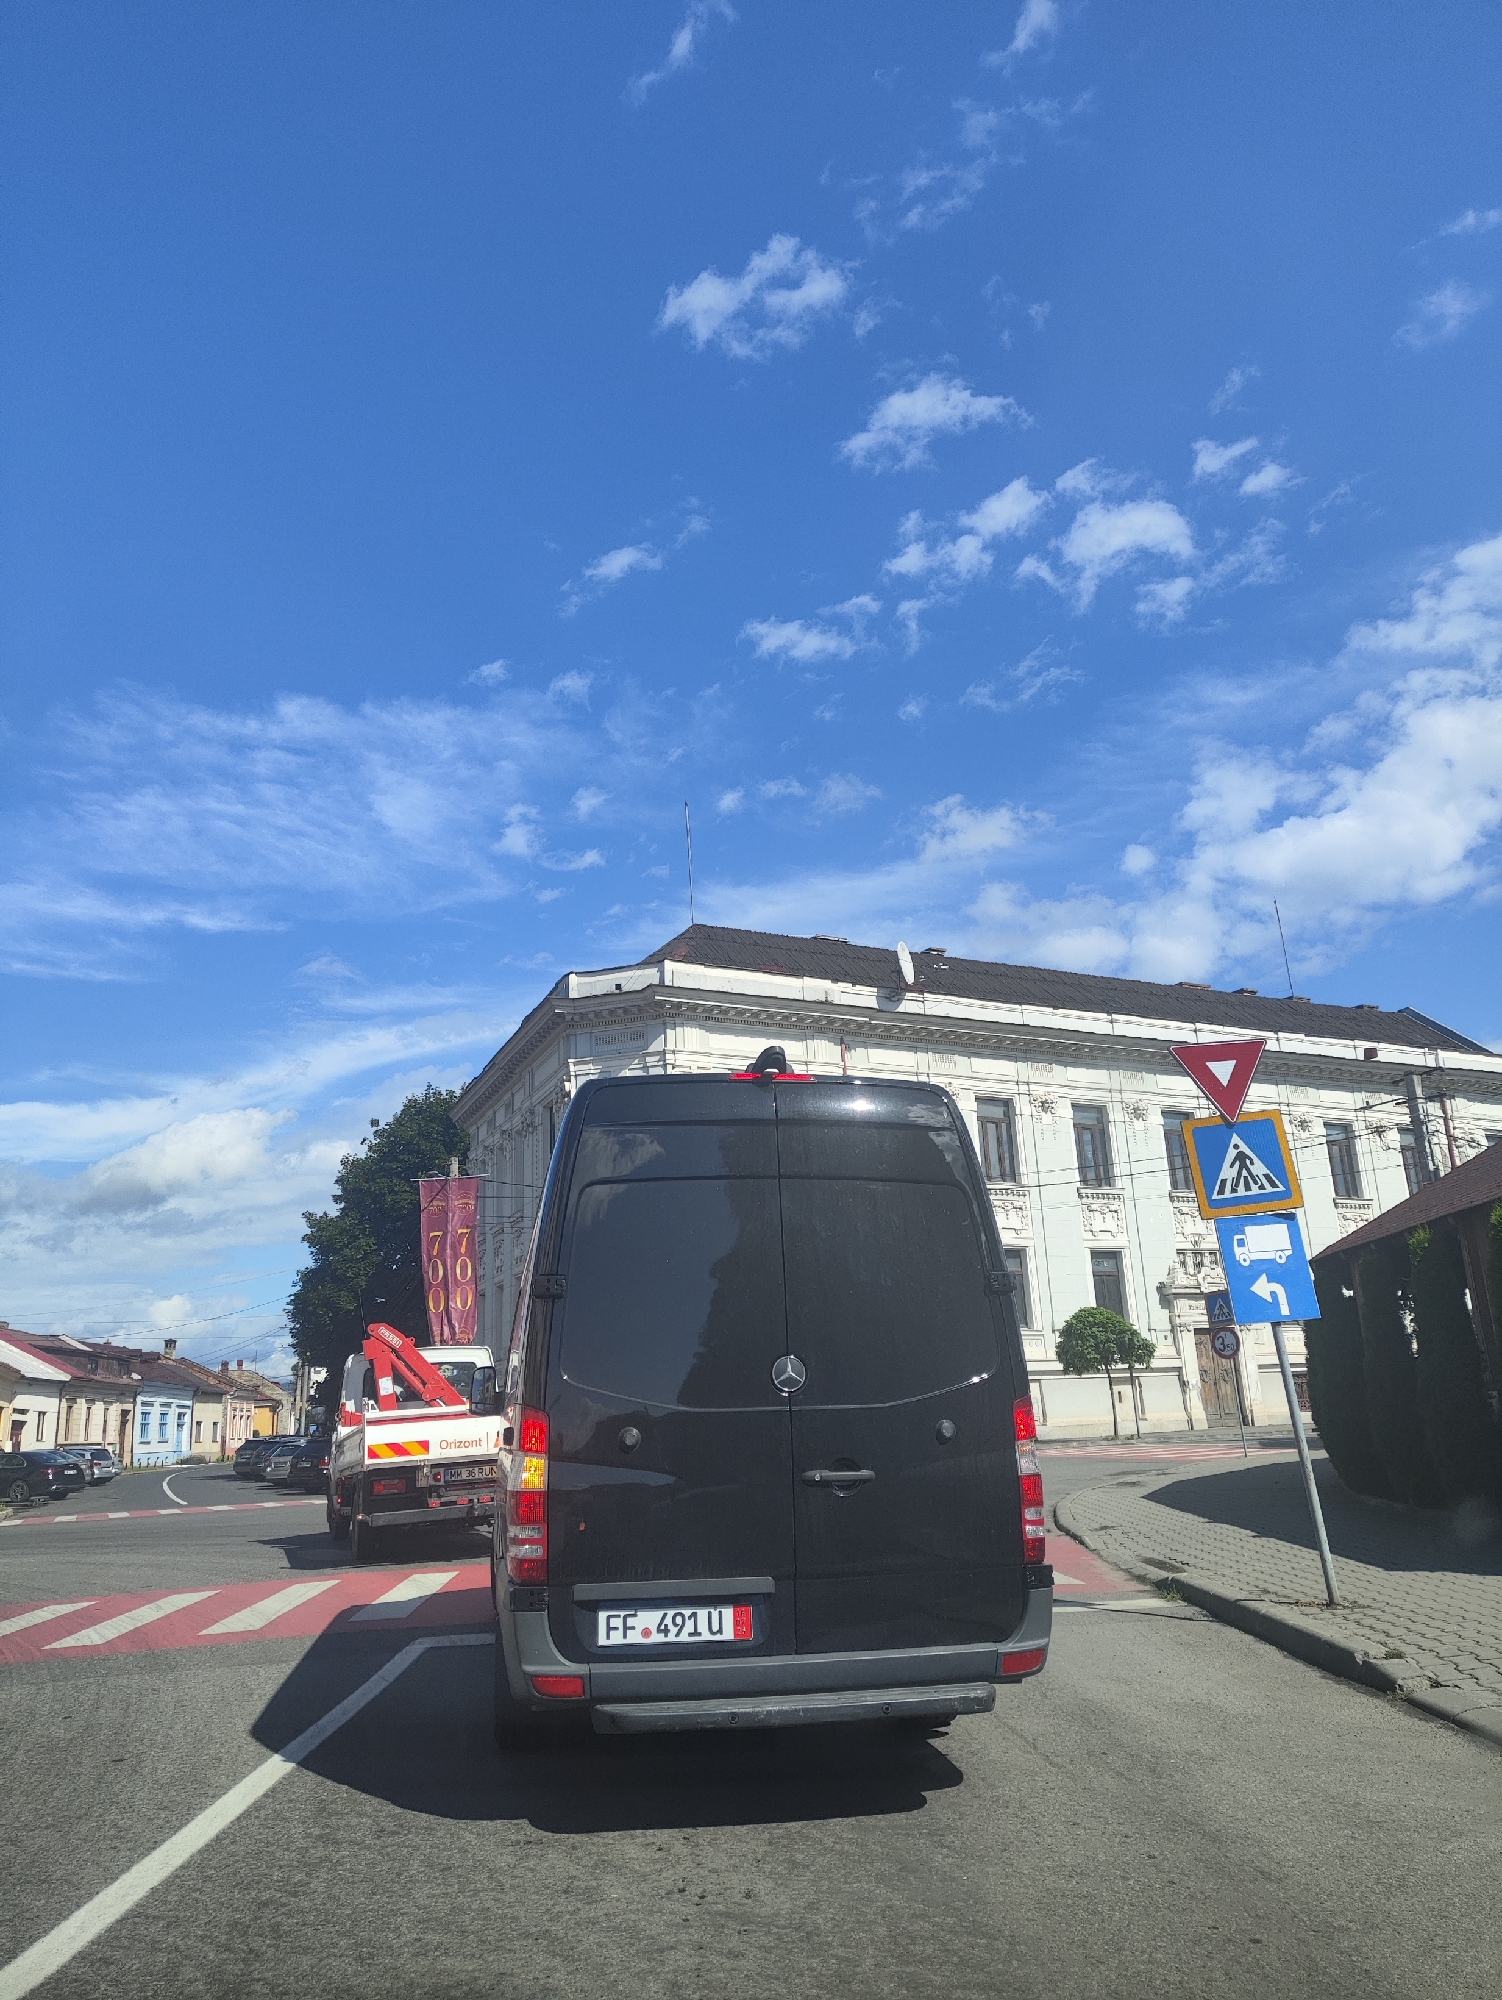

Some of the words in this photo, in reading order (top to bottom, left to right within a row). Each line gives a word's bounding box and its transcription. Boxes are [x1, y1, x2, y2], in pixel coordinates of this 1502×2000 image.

[428, 1231, 445, 1313] 700
[455, 1228, 473, 1311] 700
[439, 1437, 482, 1450] Orizont
[466, 1468, 477, 1478] 36
[605, 1613, 638, 1641] FF
